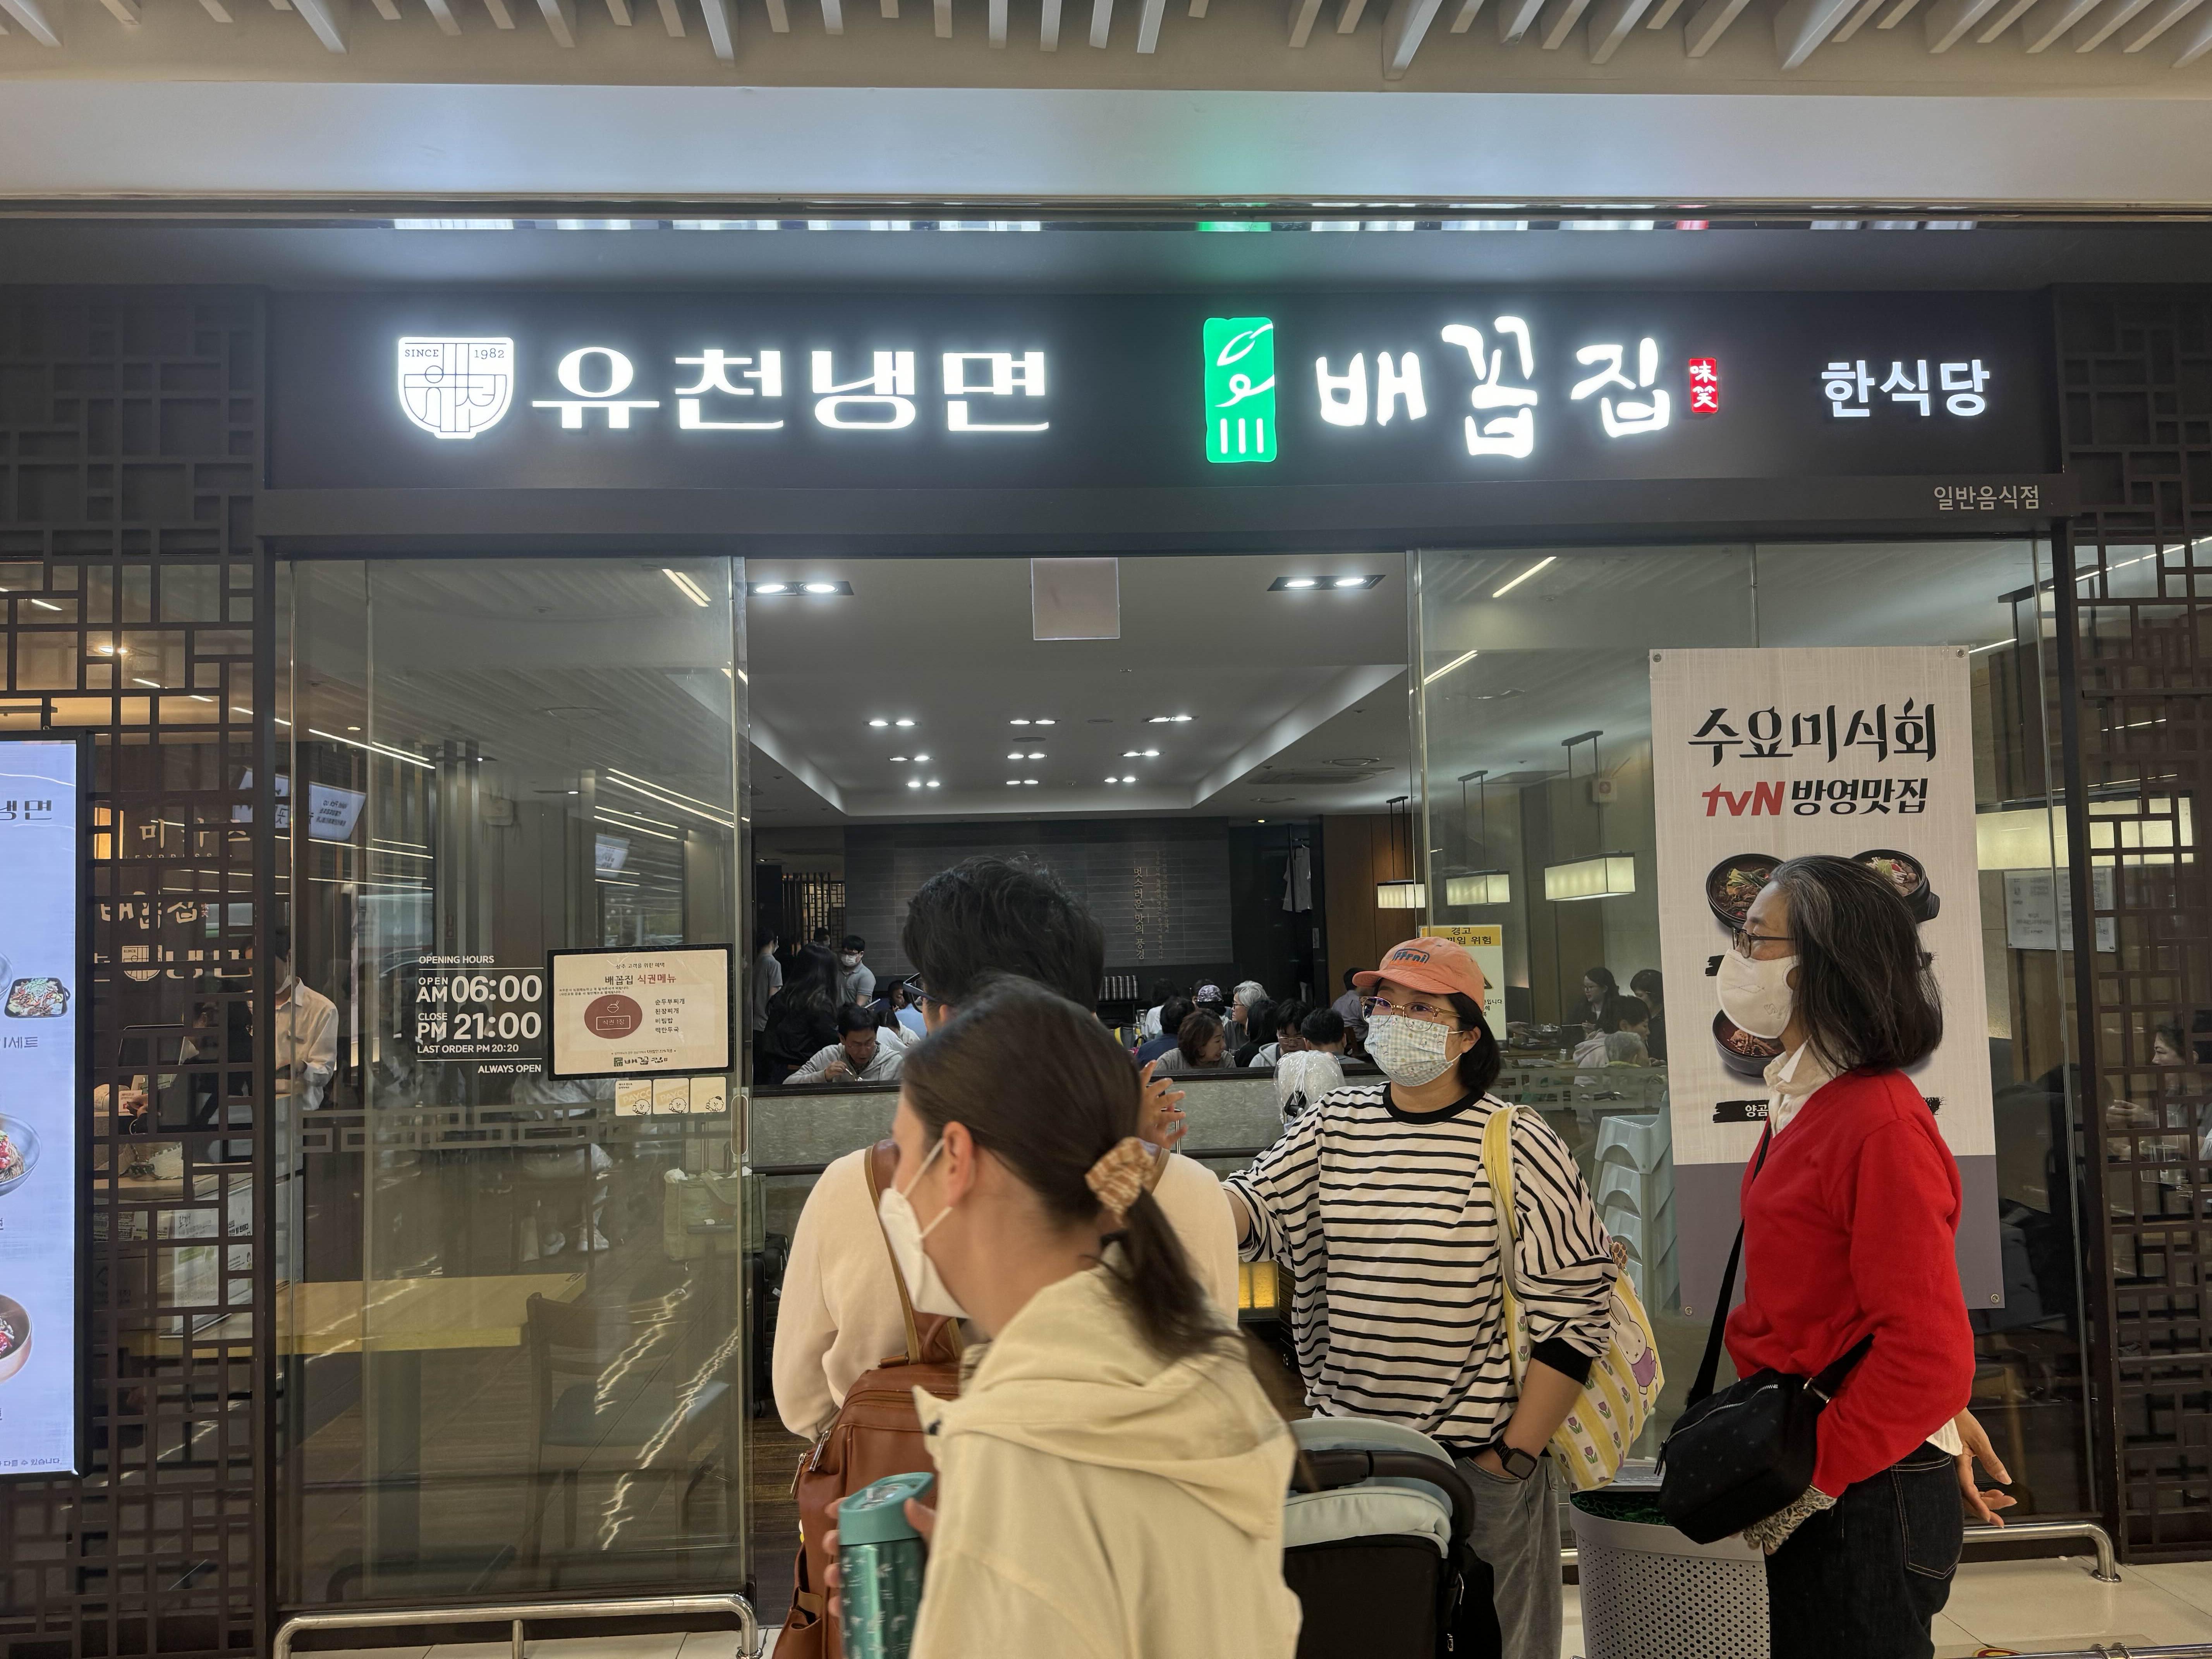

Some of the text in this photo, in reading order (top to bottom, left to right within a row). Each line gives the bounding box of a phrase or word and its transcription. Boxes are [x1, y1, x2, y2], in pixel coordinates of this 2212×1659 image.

[474, 348, 504, 359] 1982
[531, 345, 1050, 433] 유천냉면
[1315, 314, 1671, 459] 배꼽집
[1690, 360, 1718, 409] 味笑
[1821, 359, 1990, 417] 한식당
[1934, 485, 2040, 511] 일반음식점
[1688, 697, 1935, 768] 수요미식회
[1701, 778, 1929, 817] tvN 방영맛집
[1133, 867, 1145, 960] 멋스러운 맛의 풍경
[1451, 927, 1472, 935] 경고
[1471, 936, 1491, 944] 위험
[419, 955, 495, 964] OPENING HOURS
[416, 975, 542, 1003] AM 06:00
[418, 977, 448, 985] OPEN
[605, 974, 677, 985] 배꼽집 식권메뉴
[418, 1012, 541, 1039] PM 21:00
[441, 1045, 474, 1053] ORDER
[492, 1044, 519, 1052] 20:20
[477, 1065, 541, 1073] ALWAYS OPEN
[1745, 1104, 1769, 1117] 양곰
